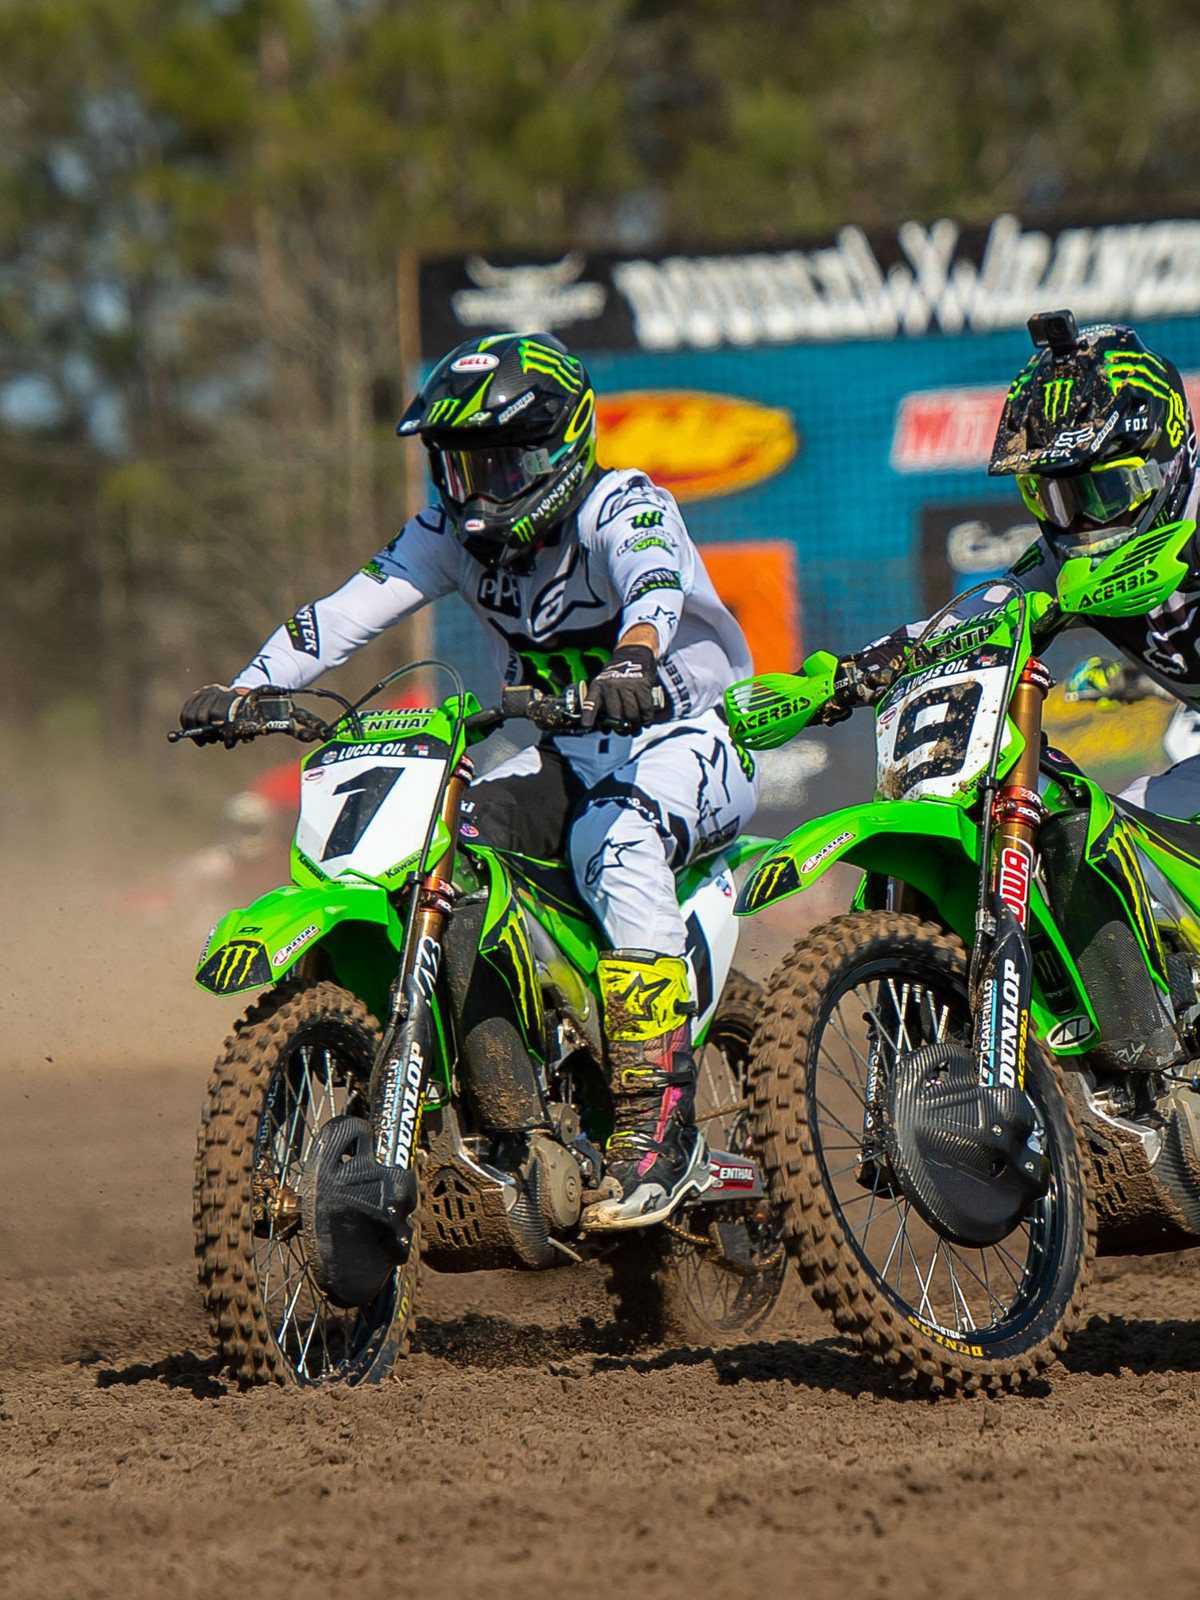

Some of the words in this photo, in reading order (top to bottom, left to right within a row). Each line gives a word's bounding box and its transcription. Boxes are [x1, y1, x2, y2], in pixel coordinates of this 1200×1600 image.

[457, 356, 491, 367] BELL
[1125, 418, 1148, 431] FOX
[905, 665, 945, 693] LUCAS
[944, 659, 969, 675] OIL
[338, 743, 381, 760] LUCAS
[381, 743, 406, 756] OIL
[320, 766, 406, 862] 1
[1000, 958, 1020, 1089] DUNLOP
[395, 1041, 424, 1170] DUNLOP
[908, 1315, 984, 1357] DUNLOP
